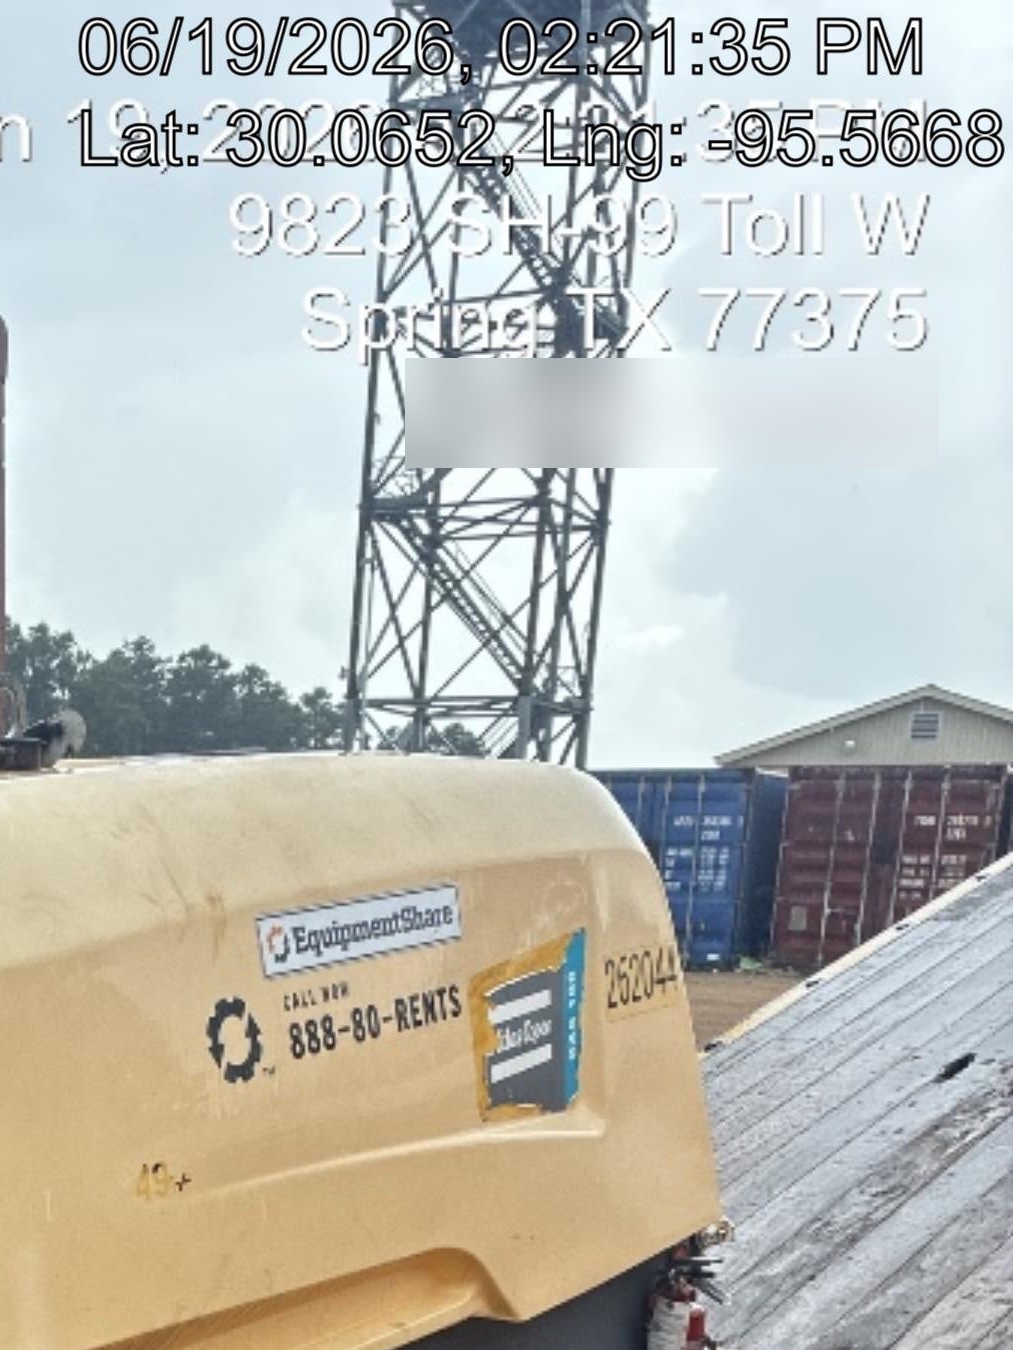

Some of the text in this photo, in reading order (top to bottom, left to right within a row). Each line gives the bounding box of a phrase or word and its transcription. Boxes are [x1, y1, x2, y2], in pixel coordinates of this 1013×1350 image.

[291, 905, 454, 958] EquipmentShare
[283, 989, 318, 1012] CALL
[289, 983, 462, 1060] 888-80-RENTS
